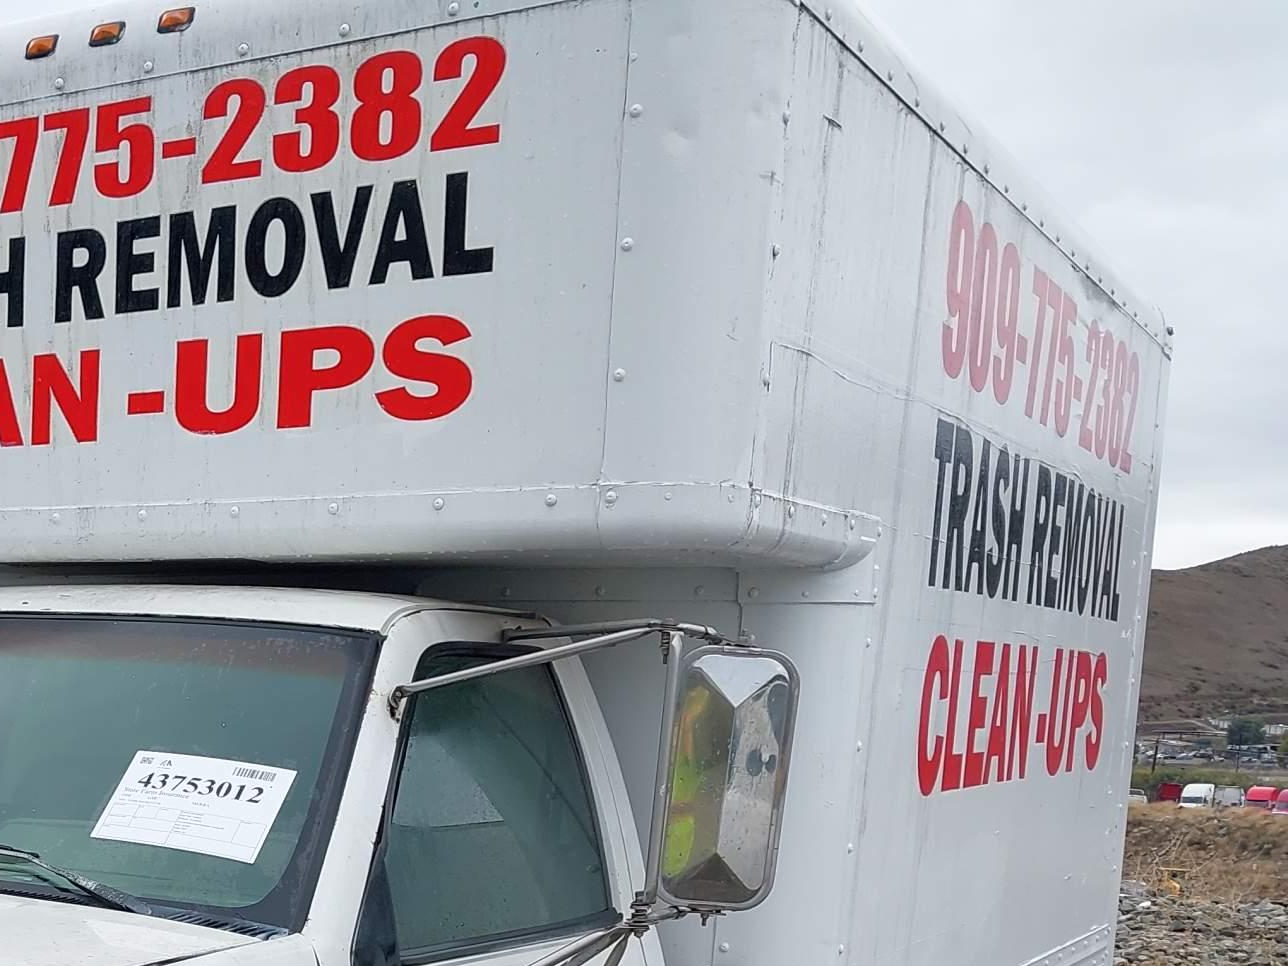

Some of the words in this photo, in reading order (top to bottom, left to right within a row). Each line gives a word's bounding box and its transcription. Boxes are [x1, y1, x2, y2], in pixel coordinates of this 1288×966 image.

[54, 172, 494, 324] REMOVAL
[942, 200, 1140, 474] 909-775-2382
[928, 417, 1030, 602] TRASH
[1027, 463, 1125, 622] REMOVAL
[137, 772, 264, 804] 43753012
